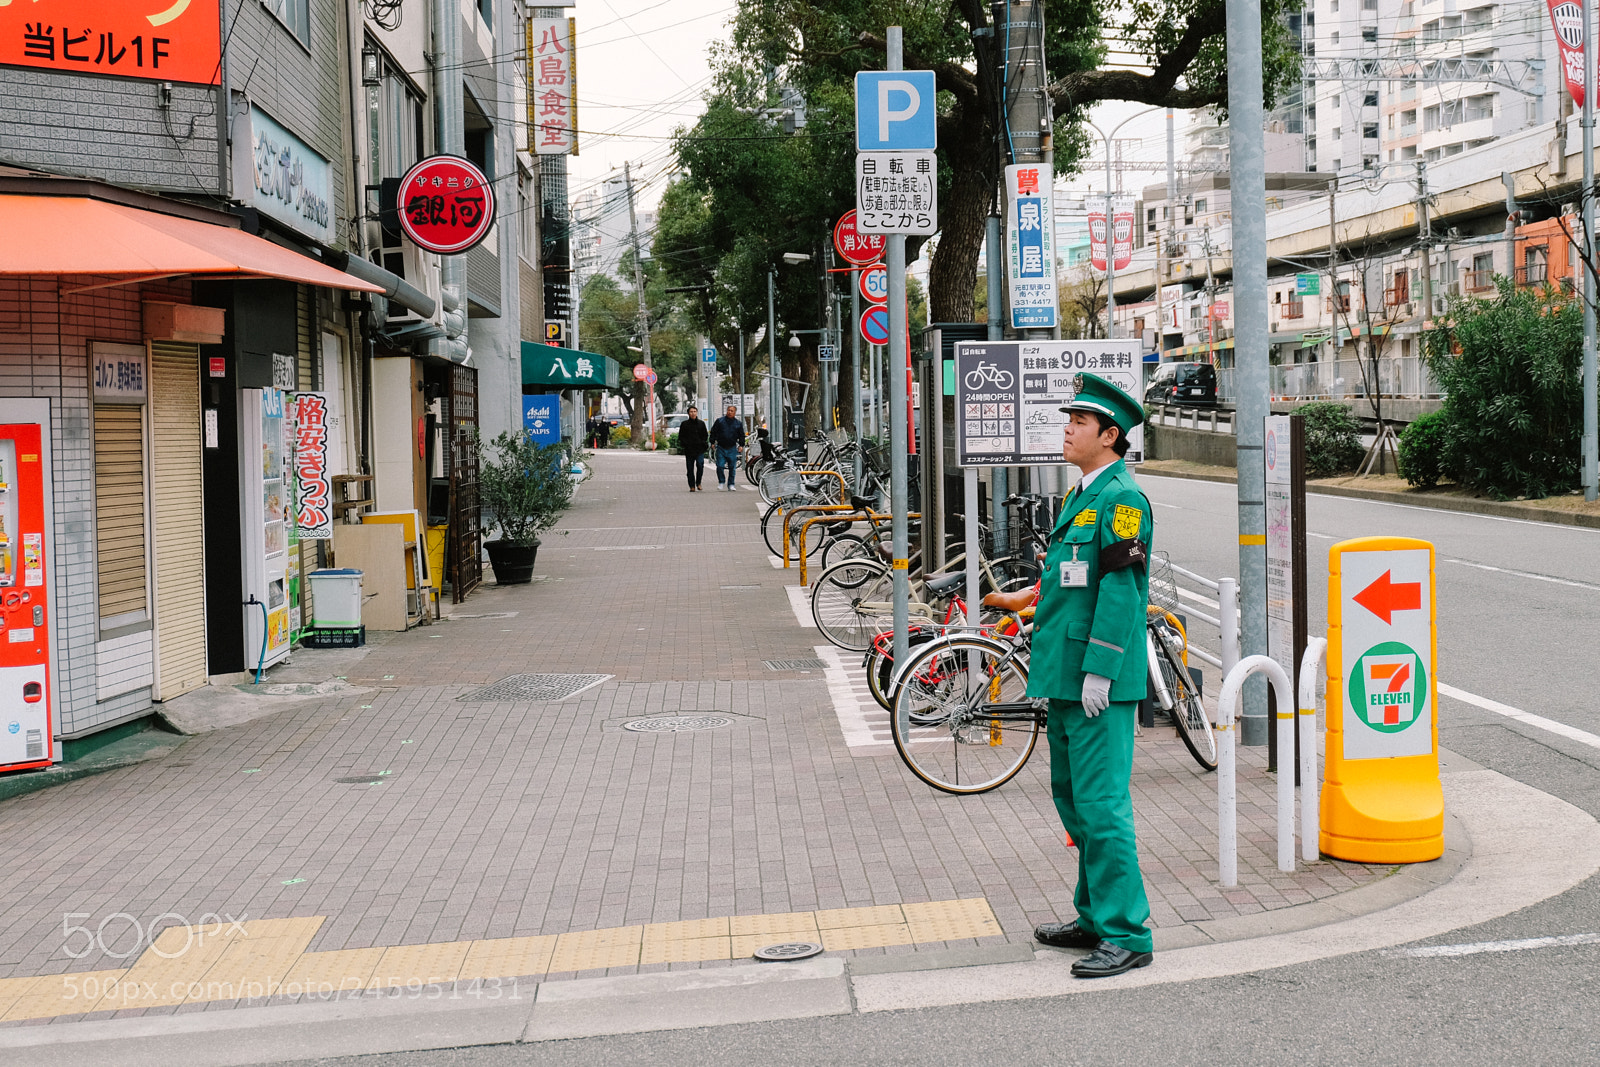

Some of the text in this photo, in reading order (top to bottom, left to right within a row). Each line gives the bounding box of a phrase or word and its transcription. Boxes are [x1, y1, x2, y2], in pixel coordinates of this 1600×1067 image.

[24, 22, 170, 69] 当ビル1F
[537, 25, 568, 147] 八島食堂
[878, 80, 921, 141] P
[863, 158, 931, 174] 自転車
[416, 176, 474, 188] ヤキニク
[1017, 169, 1039, 194] 質
[407, 195, 483, 228] 銀河
[863, 213, 931, 228] ここから
[844, 234, 882, 250] 消火栓
[1020, 202, 1042, 273] 泉屋
[868, 275, 887, 292] 50
[705, 350, 713, 361] P
[1023, 350, 1132, 369] 駐輪後90分無料
[548, 358, 594, 378] 八島
[965, 393, 1015, 402] 24時間OPEN
[527, 406, 549, 416] Asahi
[296, 397, 326, 528] 格安きっぷ
[1370, 663, 1410, 724] 7
